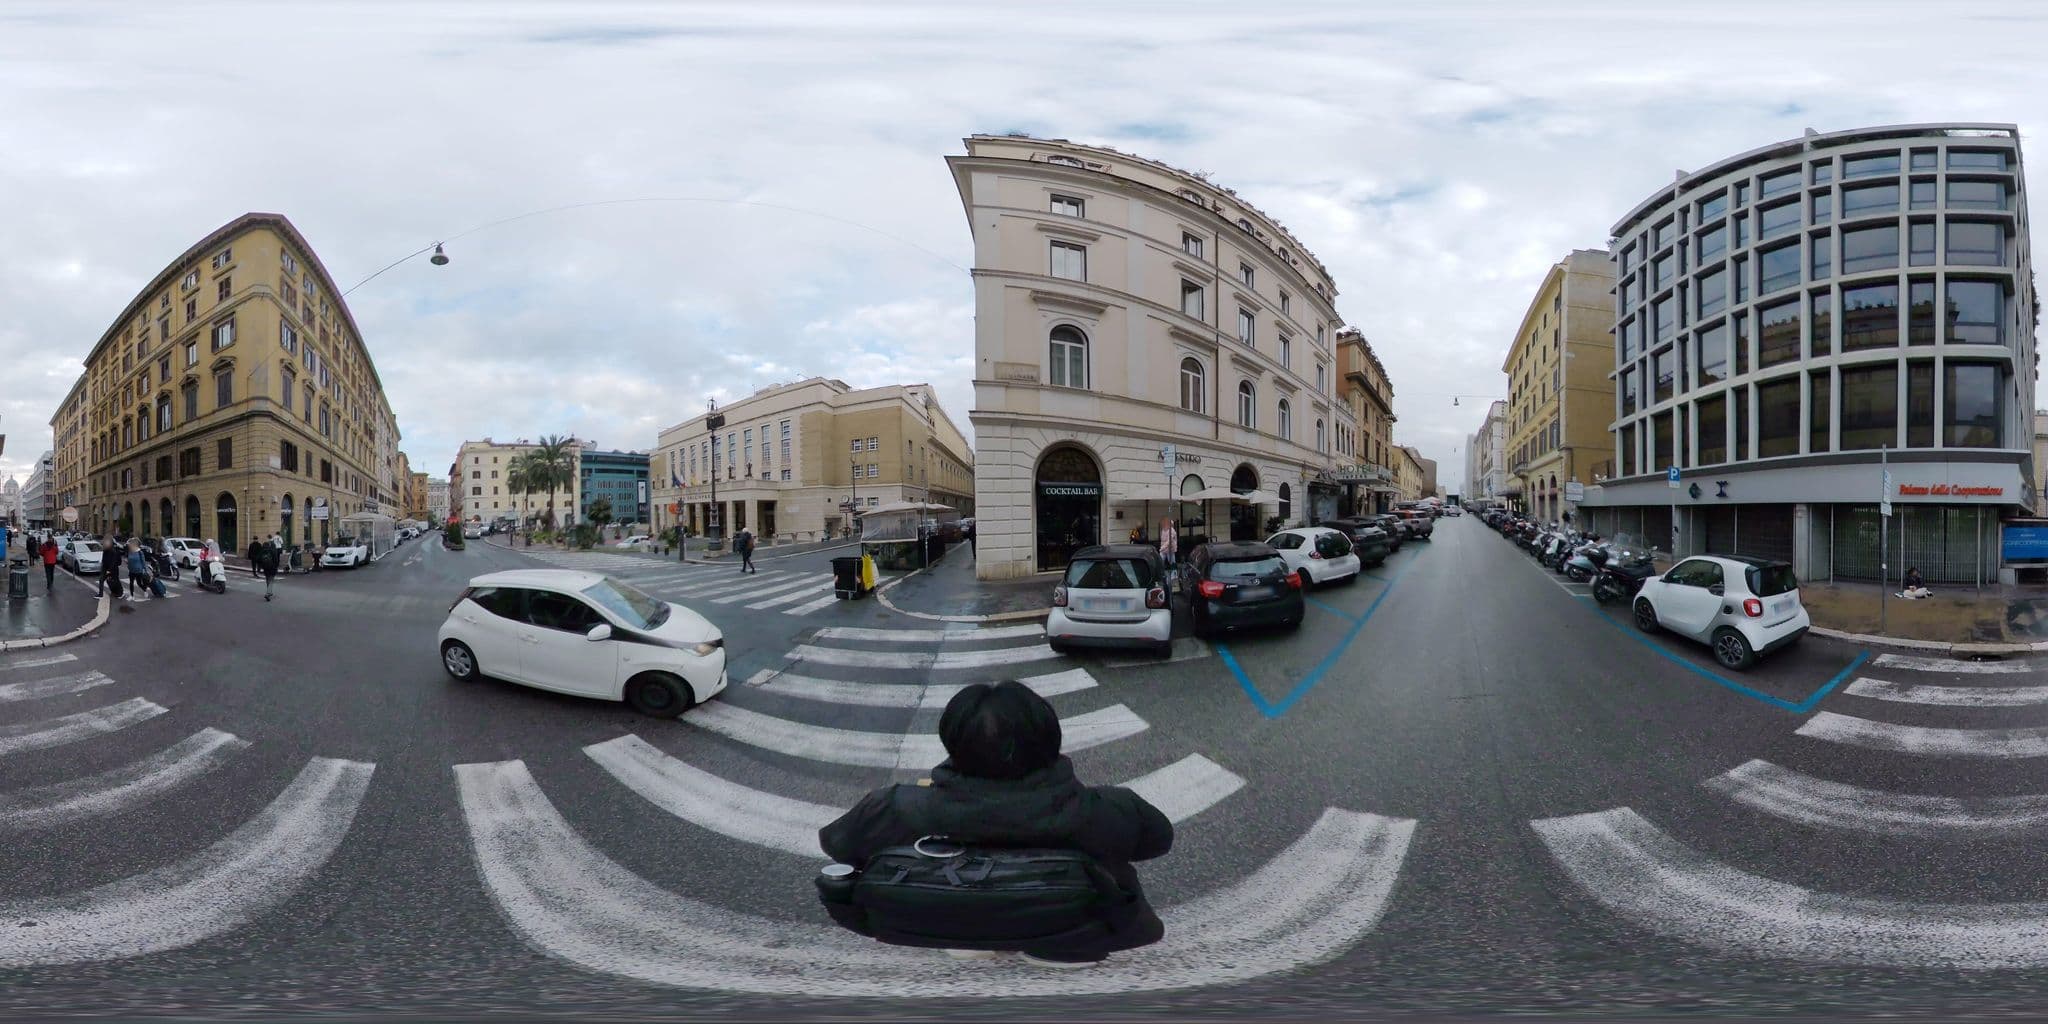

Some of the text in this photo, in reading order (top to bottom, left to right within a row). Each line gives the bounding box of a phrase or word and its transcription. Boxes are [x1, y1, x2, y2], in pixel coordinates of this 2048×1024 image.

[1339, 464, 1373, 474] HOTEL
[1670, 468, 1678, 479] P
[1045, 487, 1098, 495] COCKTAIL BAR
